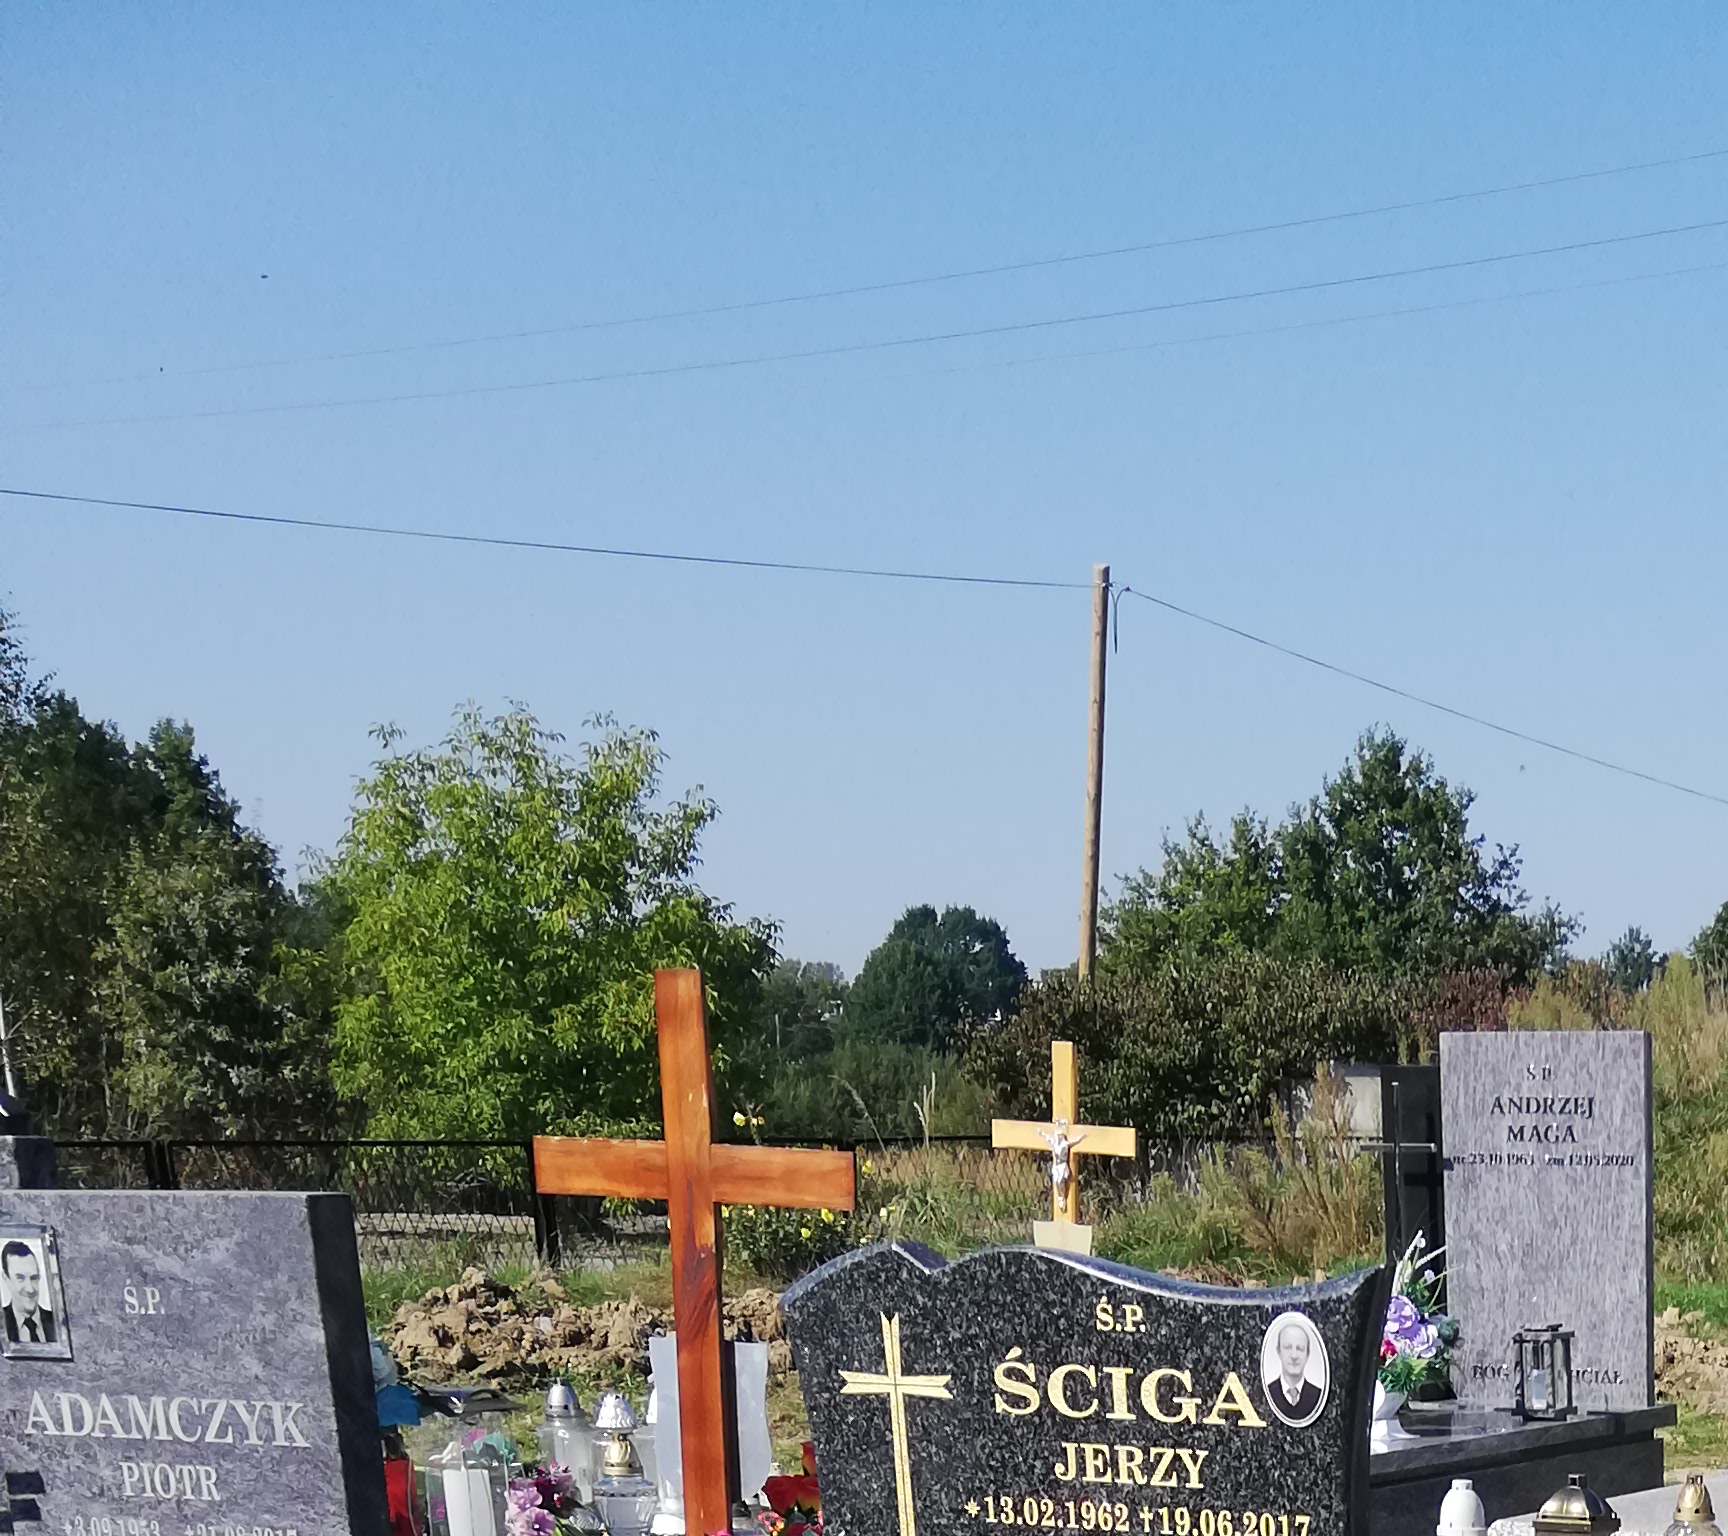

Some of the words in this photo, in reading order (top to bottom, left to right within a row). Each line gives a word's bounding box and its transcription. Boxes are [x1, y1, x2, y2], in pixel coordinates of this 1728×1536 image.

[1490, 1096, 1594, 1119] ANDRZEJ
[1506, 1124, 1579, 1144] MAGA
[124, 1279, 166, 1316] Ś.P.
[1096, 1296, 1147, 1333] Ś.P.
[993, 1347, 1267, 1428] ŚCIGA
[1571, 1368, 1624, 1385] HCIAŁ
[25, 1390, 311, 1448] ADAMCZYK
[119, 1461, 221, 1501] PIOTR
[1054, 1442, 1209, 1489] JERZY
